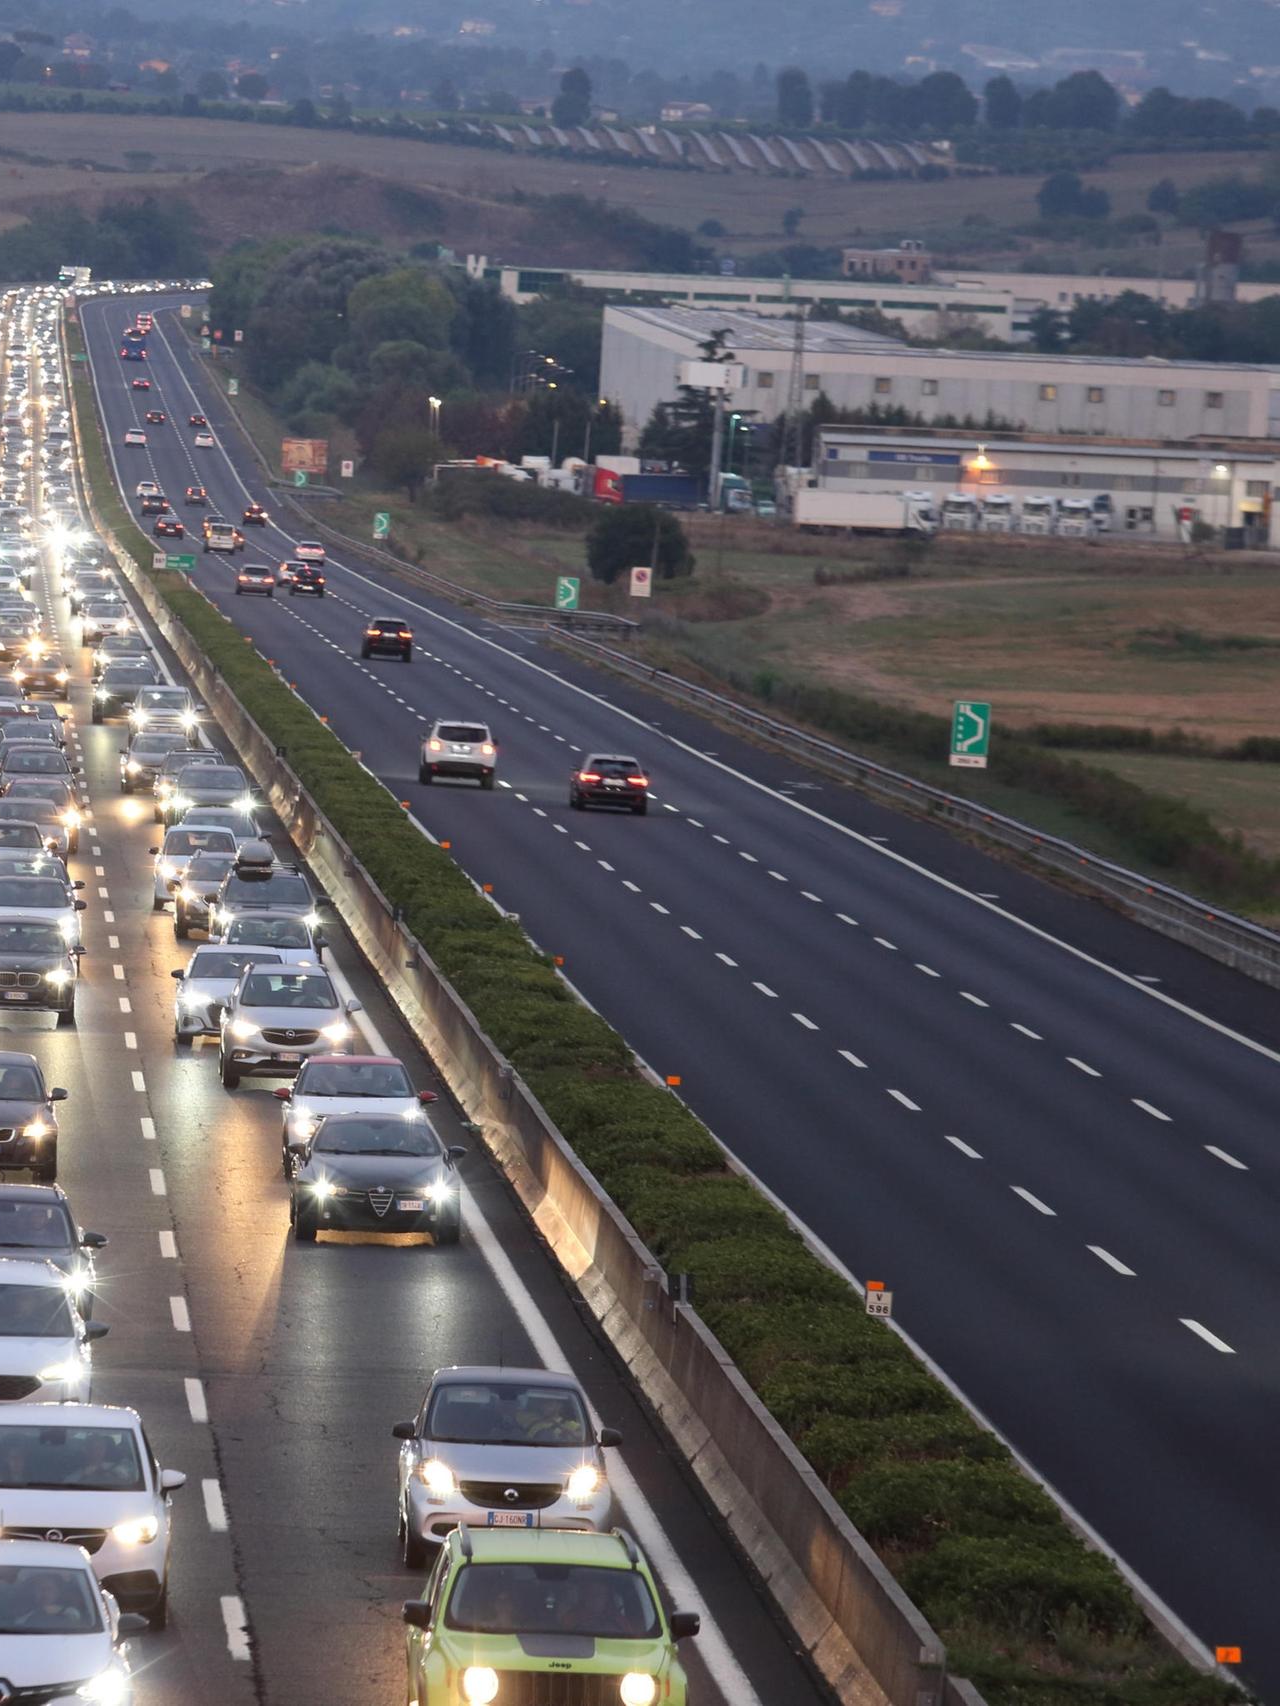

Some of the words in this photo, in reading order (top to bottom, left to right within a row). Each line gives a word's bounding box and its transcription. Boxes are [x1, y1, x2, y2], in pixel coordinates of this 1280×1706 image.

[876, 1293, 883, 1301] V
[868, 1304, 889, 1315] 596
[548, 1661, 572, 1670] Jeep
